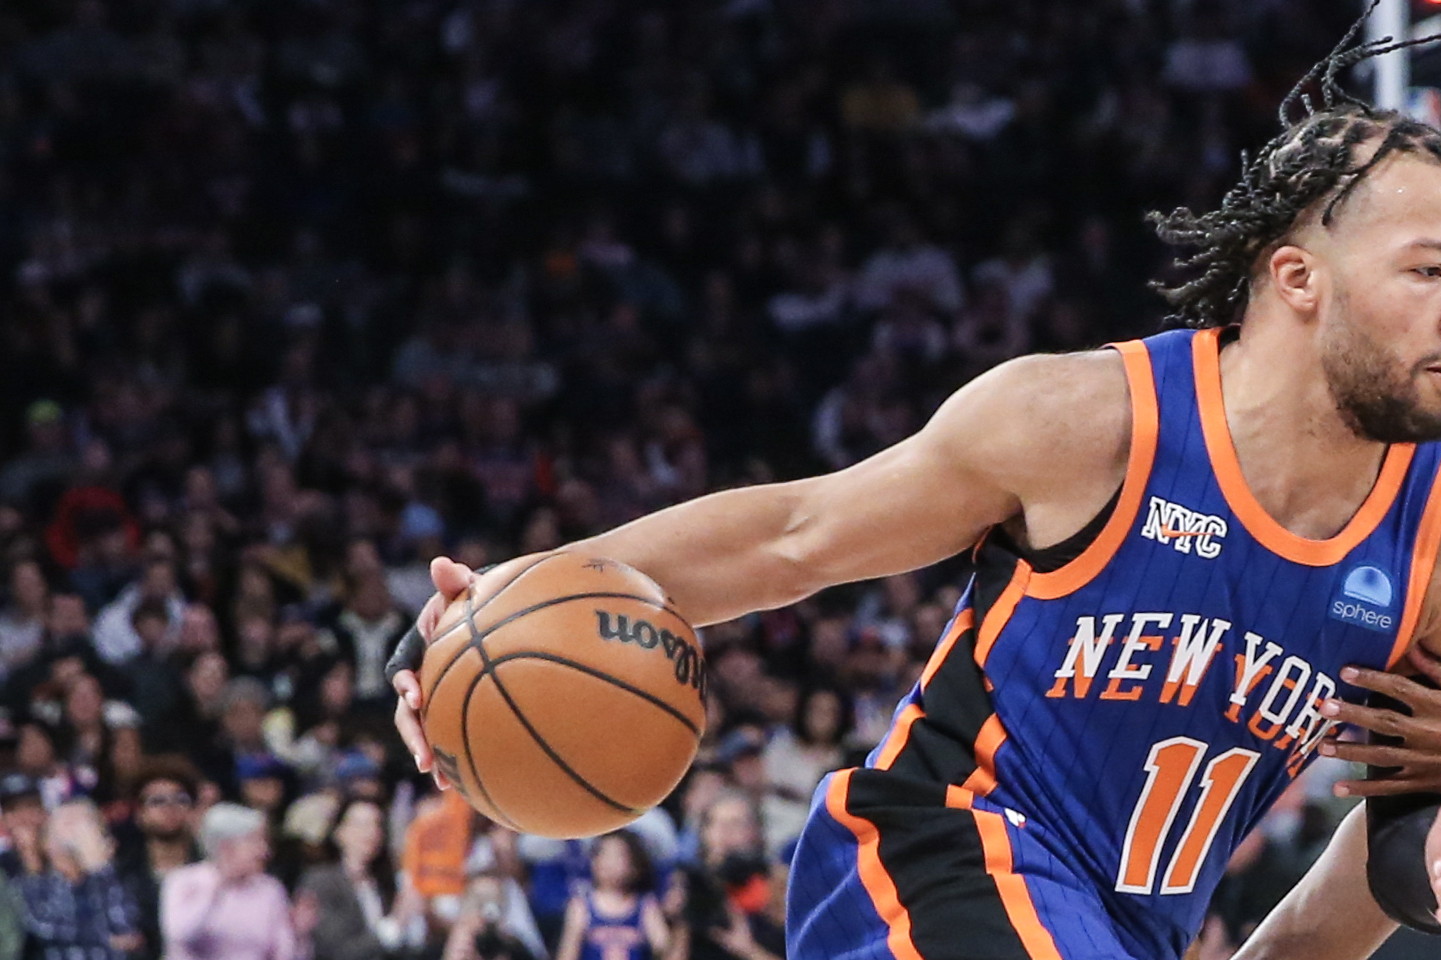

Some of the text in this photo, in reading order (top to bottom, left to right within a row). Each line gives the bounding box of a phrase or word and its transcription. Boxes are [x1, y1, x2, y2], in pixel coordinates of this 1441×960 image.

[1141, 496, 1228, 559] NYC
[594, 609, 706, 700] ilson
[1050, 612, 1231, 700] NEW
[1333, 601, 1391, 628] sphere
[1115, 736, 1261, 895] 11
